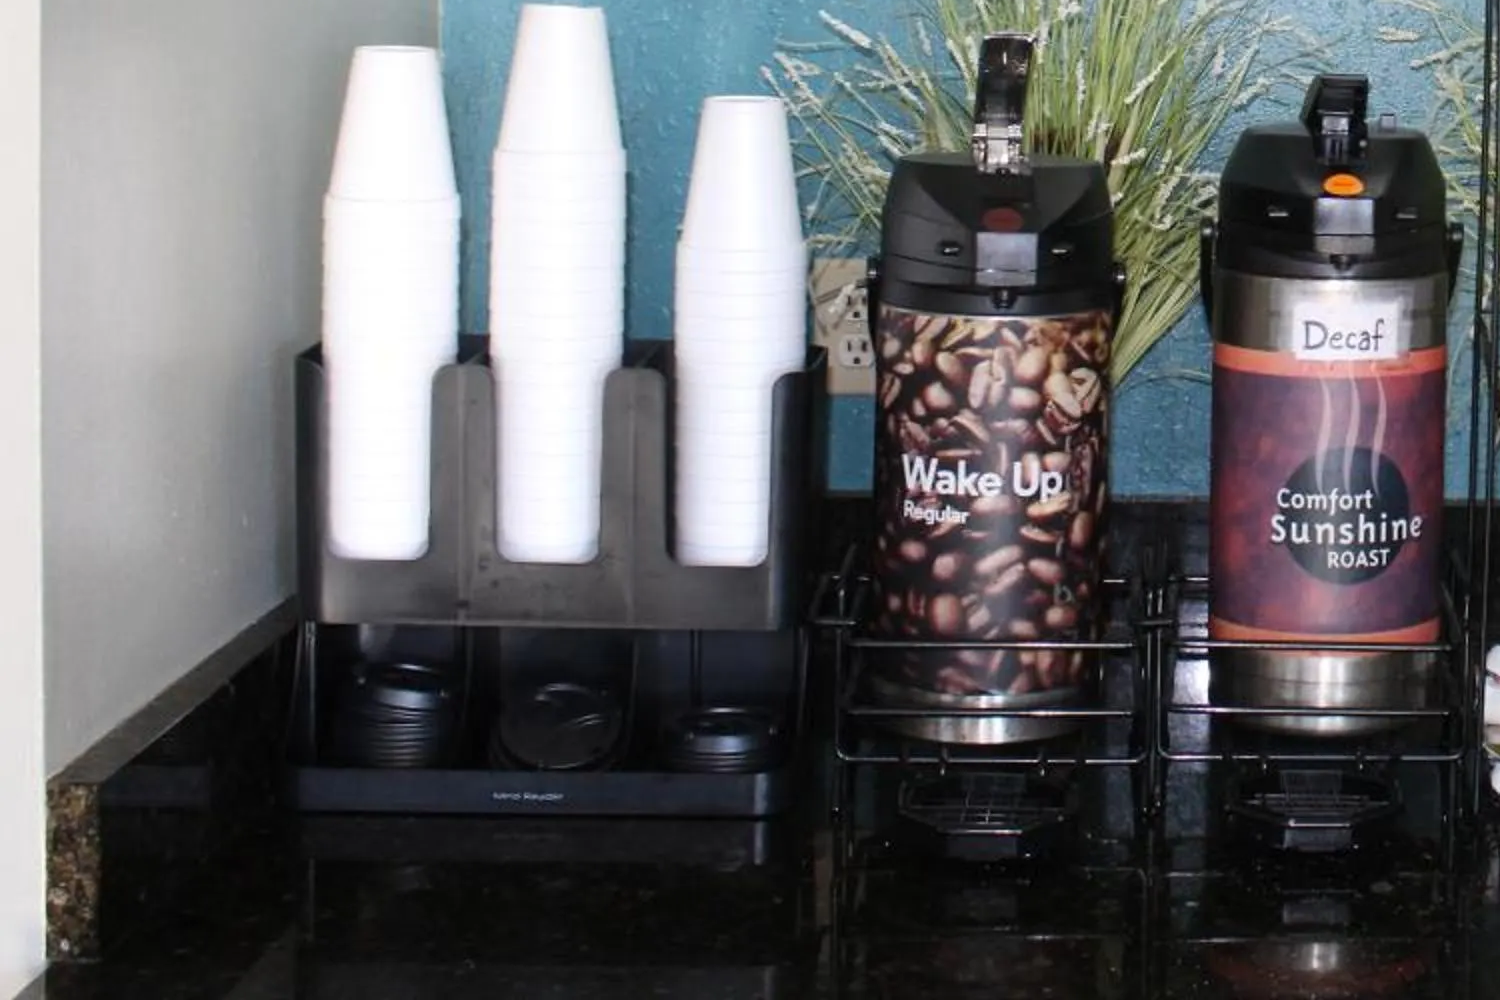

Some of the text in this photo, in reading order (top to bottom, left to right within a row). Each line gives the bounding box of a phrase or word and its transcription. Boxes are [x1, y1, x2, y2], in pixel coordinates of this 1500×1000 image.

[1303, 318, 1385, 351] Decaf
[901, 452, 1063, 502] Wake Up
[903, 499, 971, 525] Regular
[1276, 486, 1375, 516] Comfort
[1270, 513, 1424, 545] Sunshine
[1327, 548, 1391, 569] ROAST
